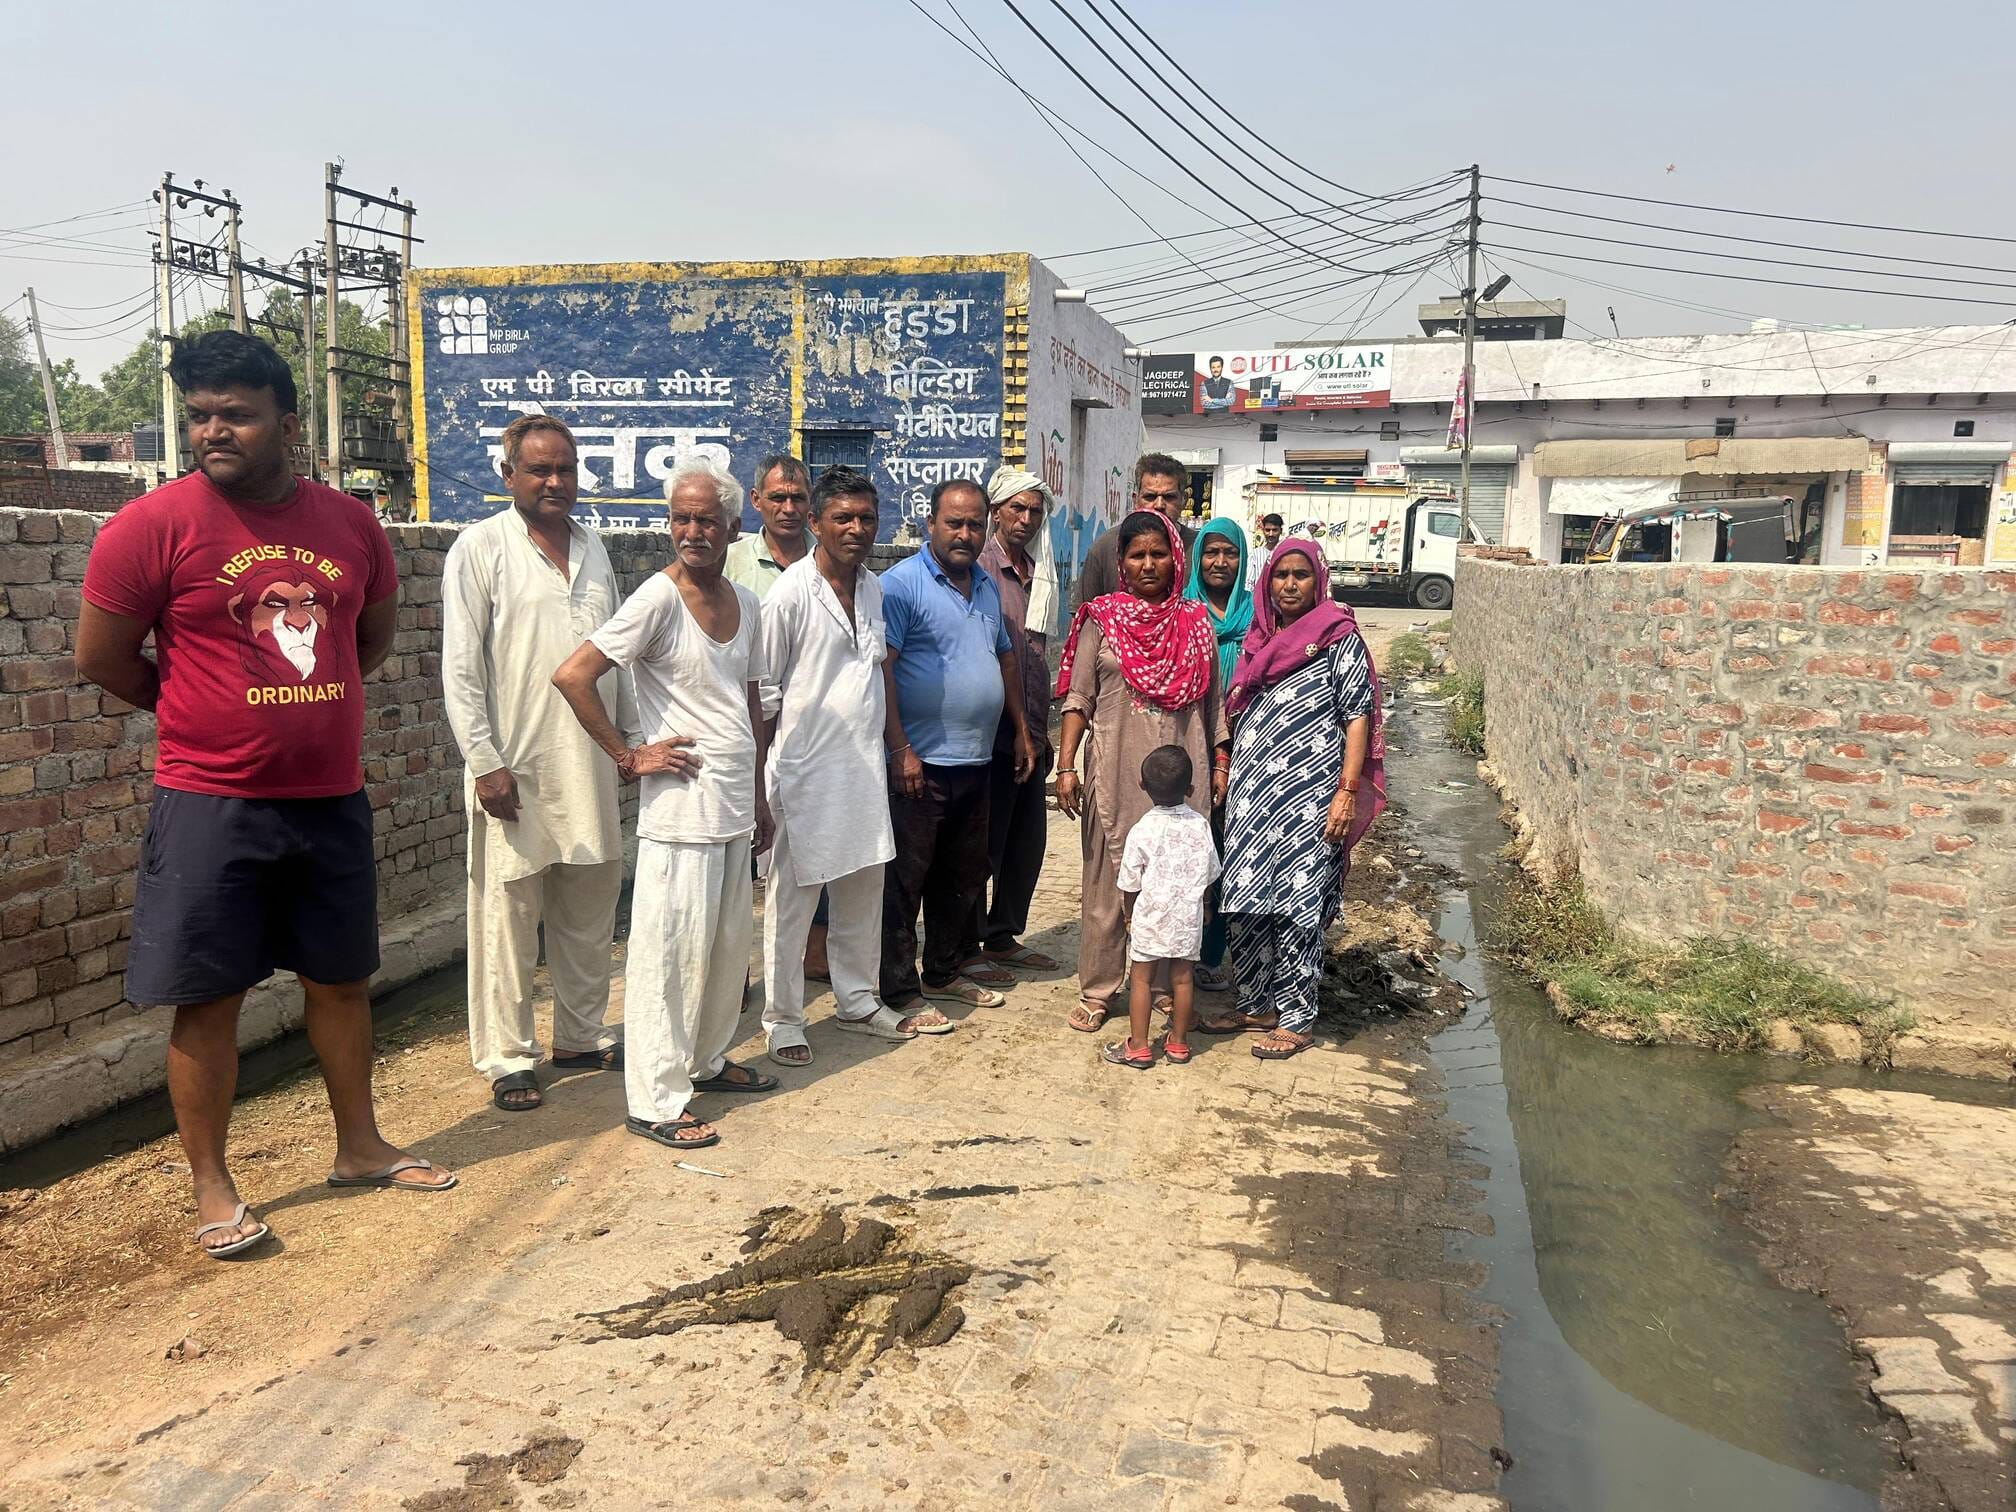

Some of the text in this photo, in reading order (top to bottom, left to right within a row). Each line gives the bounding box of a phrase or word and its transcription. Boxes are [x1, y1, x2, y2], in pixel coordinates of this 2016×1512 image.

[489, 329, 530, 341] MP BIRLA
[489, 343, 518, 354] GROUP
[1250, 355, 1298, 373] UTL
[1304, 351, 1385, 371] SOLAR
[480, 377, 517, 398] एम
[526, 370, 555, 395] पी
[1144, 371, 1184, 380] JAGDEEP
[1142, 380, 1190, 390] LECTRICAL
[215, 545, 343, 587] I REFUSE TO BE
[246, 682, 345, 705] ORDINARY
